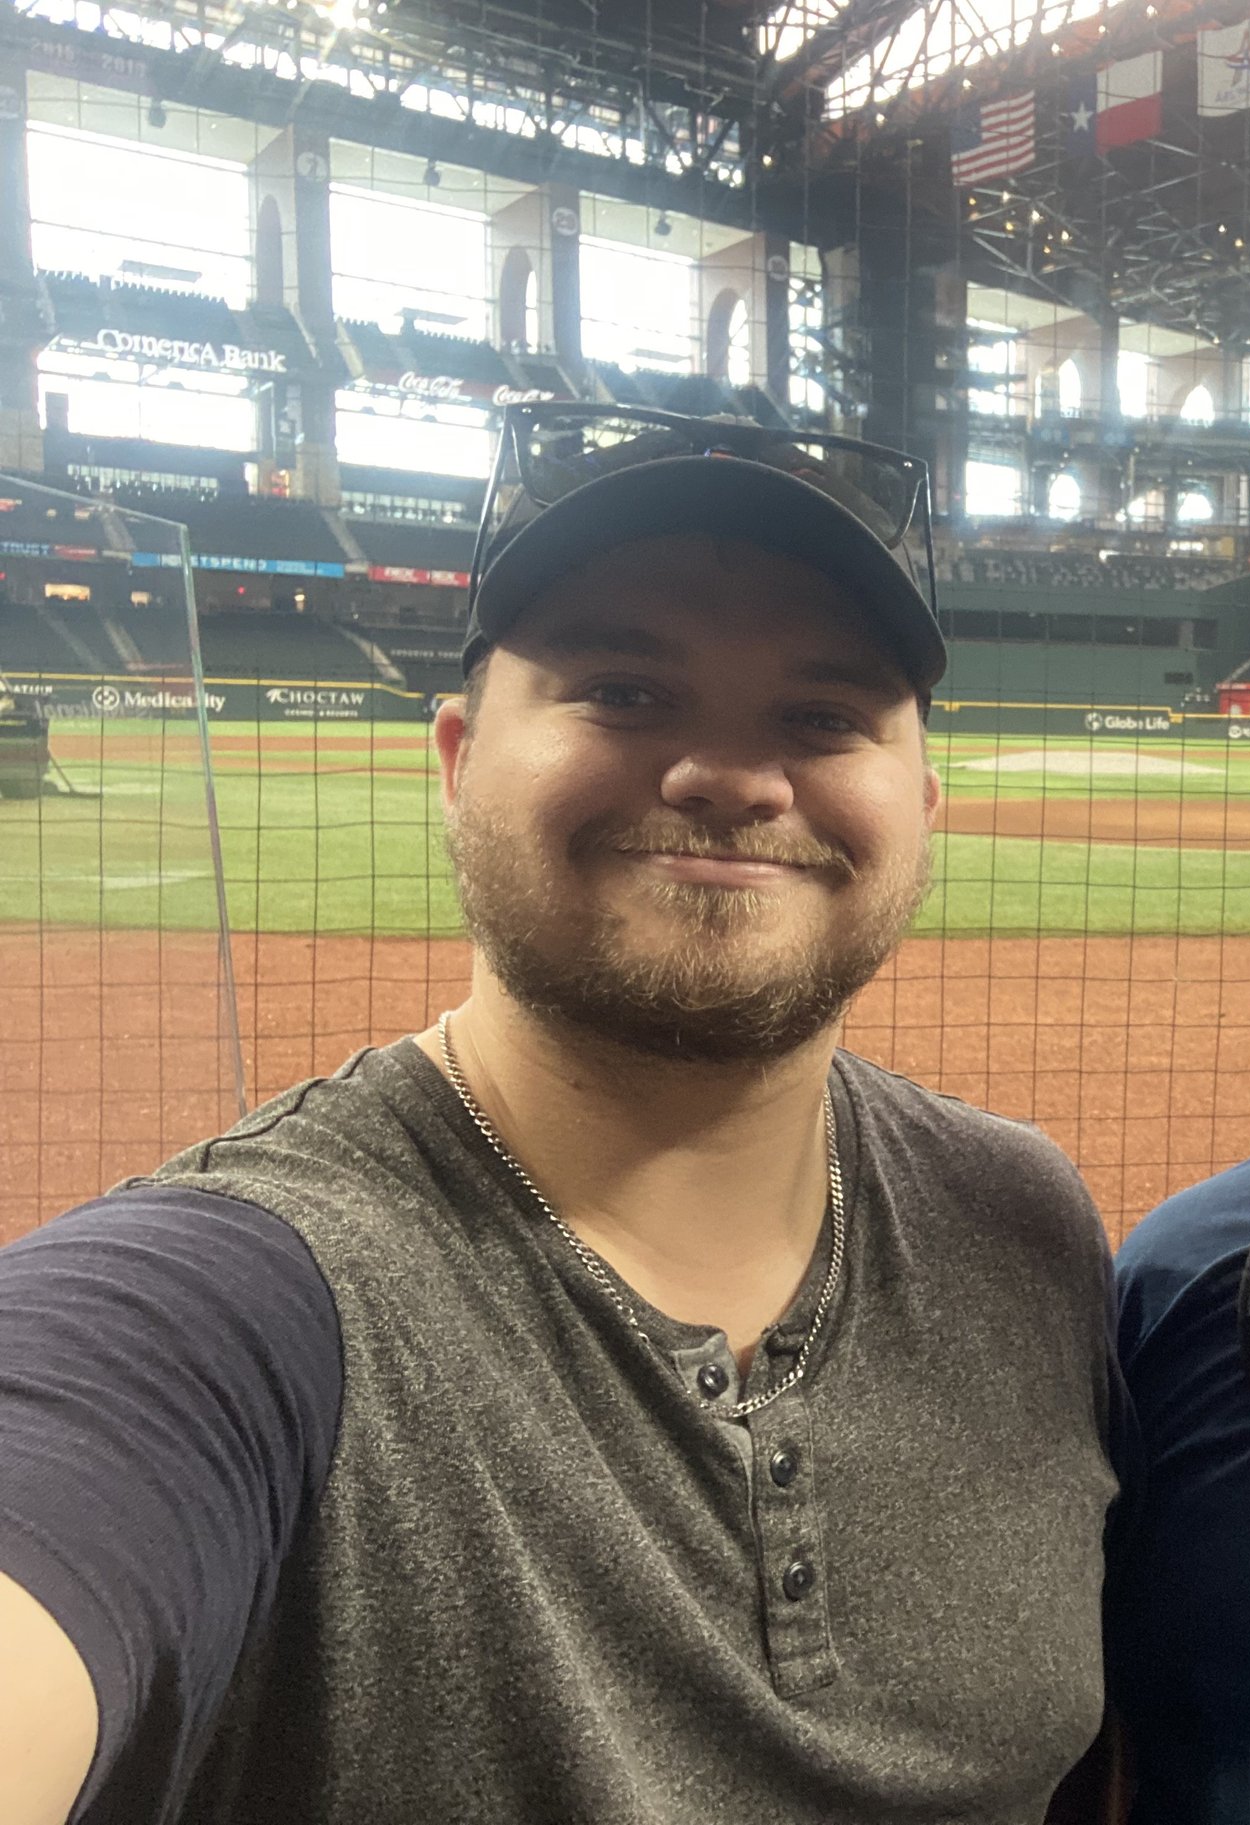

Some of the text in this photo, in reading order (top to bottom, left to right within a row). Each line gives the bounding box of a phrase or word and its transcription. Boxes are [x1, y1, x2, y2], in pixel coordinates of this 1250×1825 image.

[222, 344, 287, 373] Bank
[277, 688, 364, 705] CHOCTAW
[1145, 715, 1170, 731] Life
